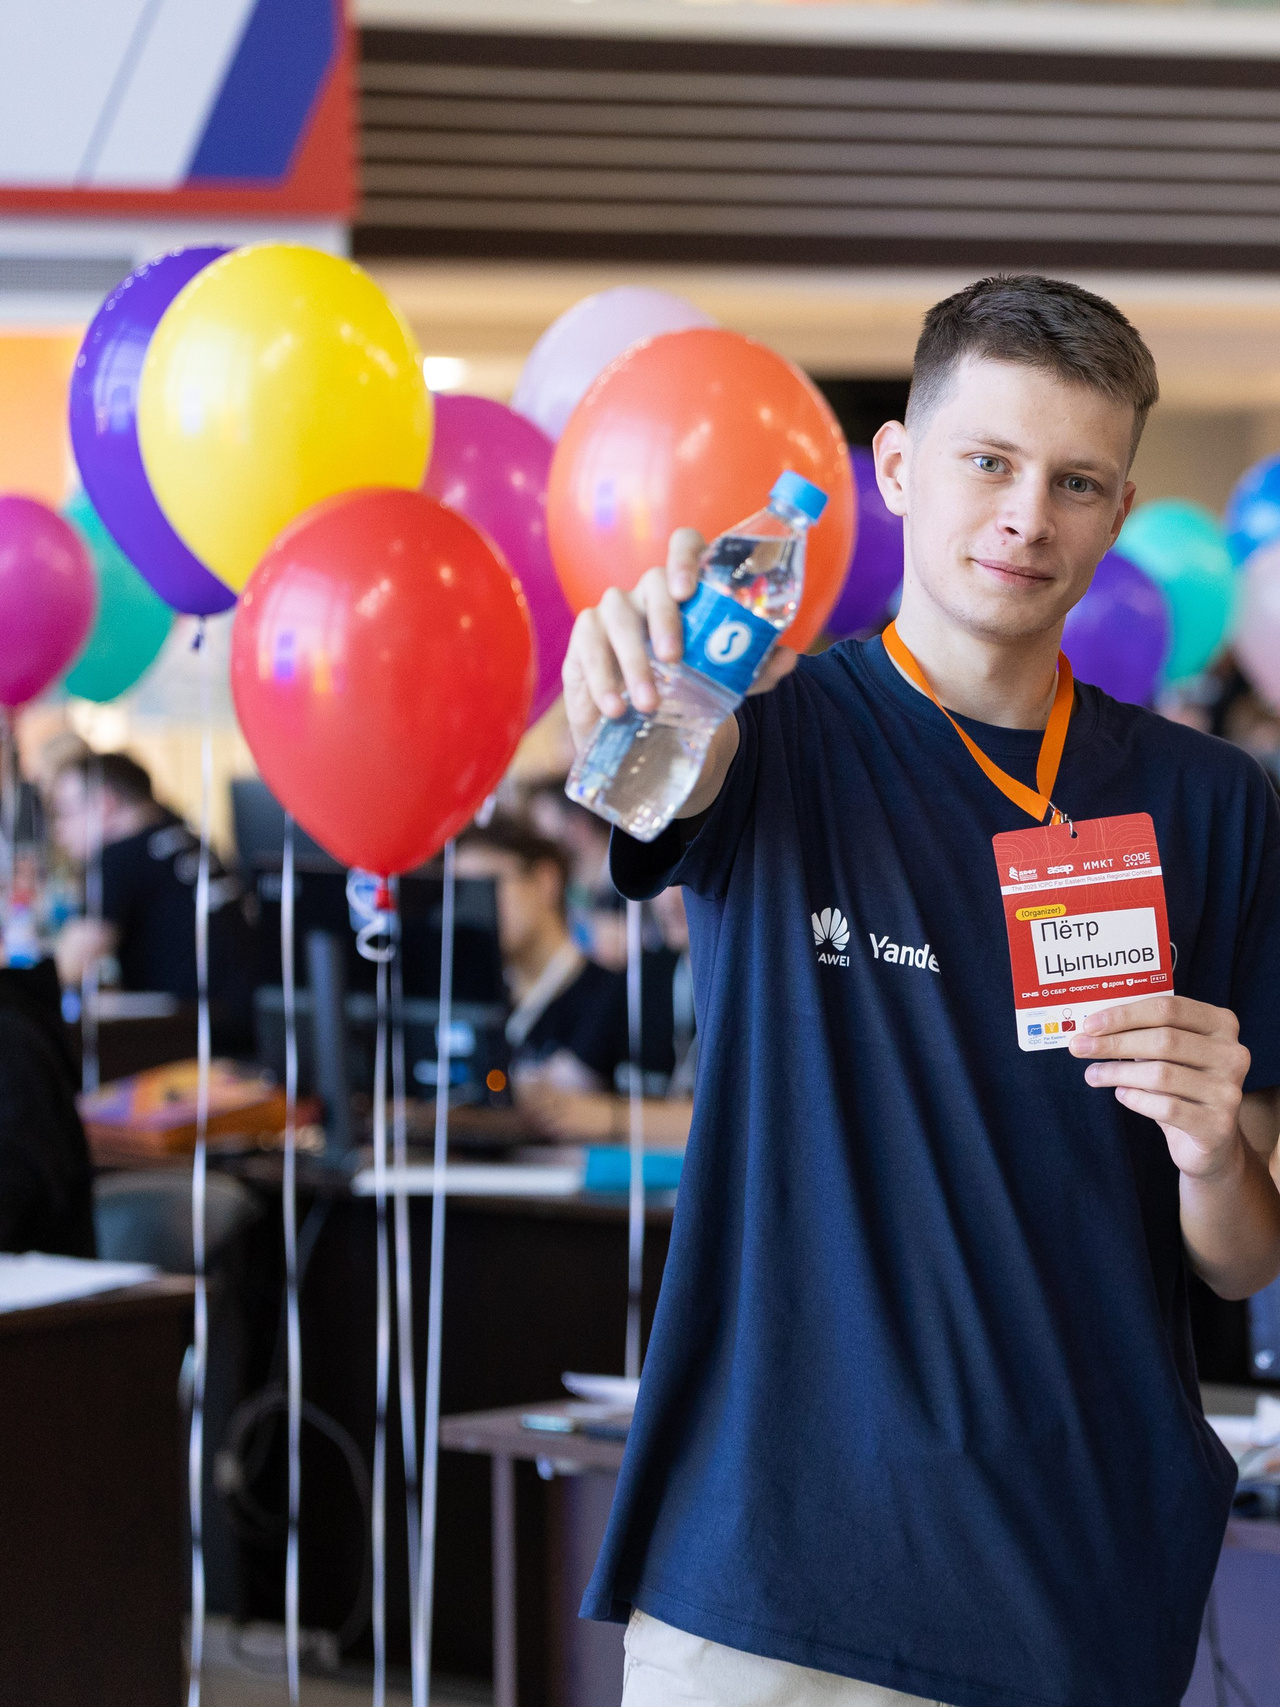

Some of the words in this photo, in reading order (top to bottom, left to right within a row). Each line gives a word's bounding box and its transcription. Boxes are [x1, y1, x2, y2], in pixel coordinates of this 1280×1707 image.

[1123, 852, 1151, 862] CODE
[1047, 864, 1074, 874] asap
[1083, 859, 1113, 870] ИМКТ
[1065, 877, 1086, 885] Eastern
[1106, 872, 1131, 880] Regional
[1021, 907, 1061, 918] {Organizer}
[1041, 920, 1099, 941] Пётр
[816, 952, 849, 967] AWEI
[869, 933, 941, 974] Yande
[1045, 947, 1155, 976] Цыпылов
